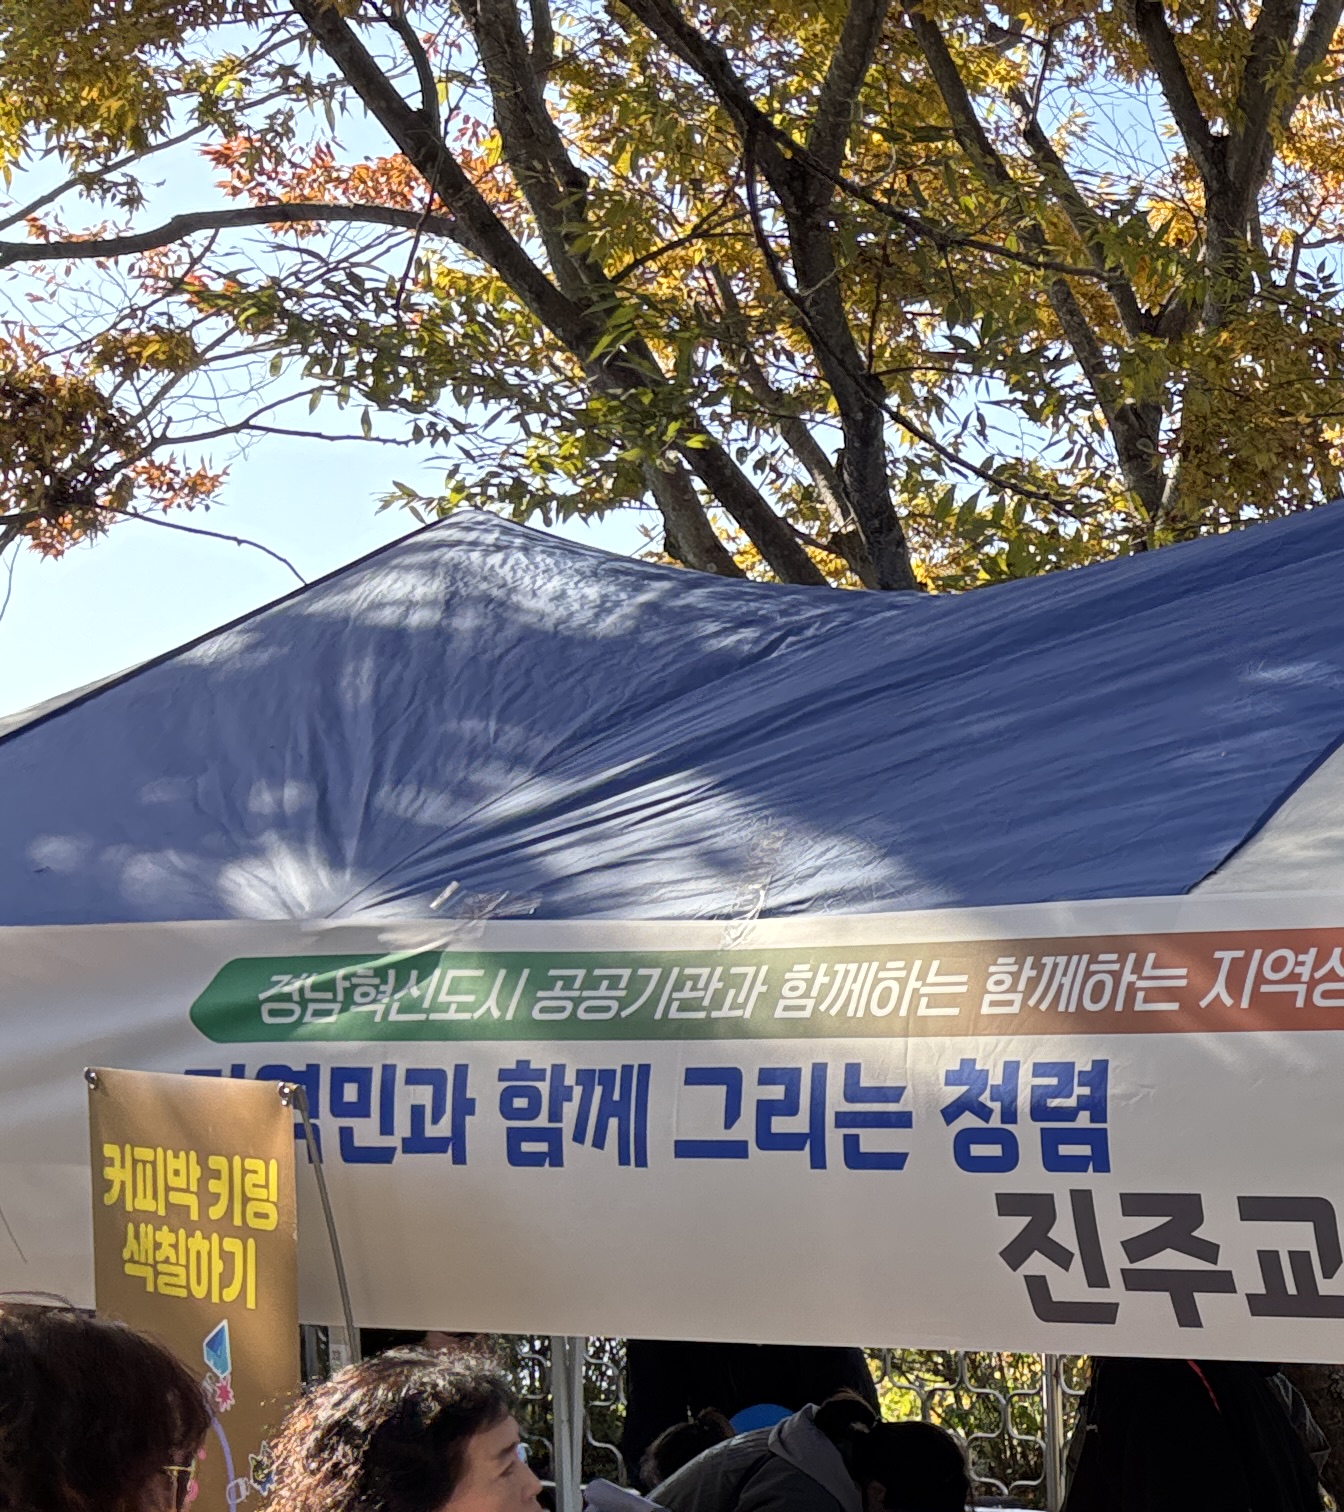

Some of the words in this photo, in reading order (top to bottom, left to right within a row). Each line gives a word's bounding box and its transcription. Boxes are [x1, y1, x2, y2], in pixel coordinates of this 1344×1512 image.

[257, 967, 530, 1025] 경남혁신도시
[531, 965, 774, 1022] 공공기관과
[773, 958, 971, 1019] 함께하는
[985, 950, 1190, 1015] 함께하는
[184, 1062, 476, 1167] 민과
[497, 1059, 652, 1169] 함께
[673, 1061, 911, 1171] 그리는
[940, 1057, 1113, 1174] 청렴
[102, 1143, 202, 1222] 커피박
[206, 1153, 280, 1232] 키링
[121, 1221, 258, 1311] 색칠하기
